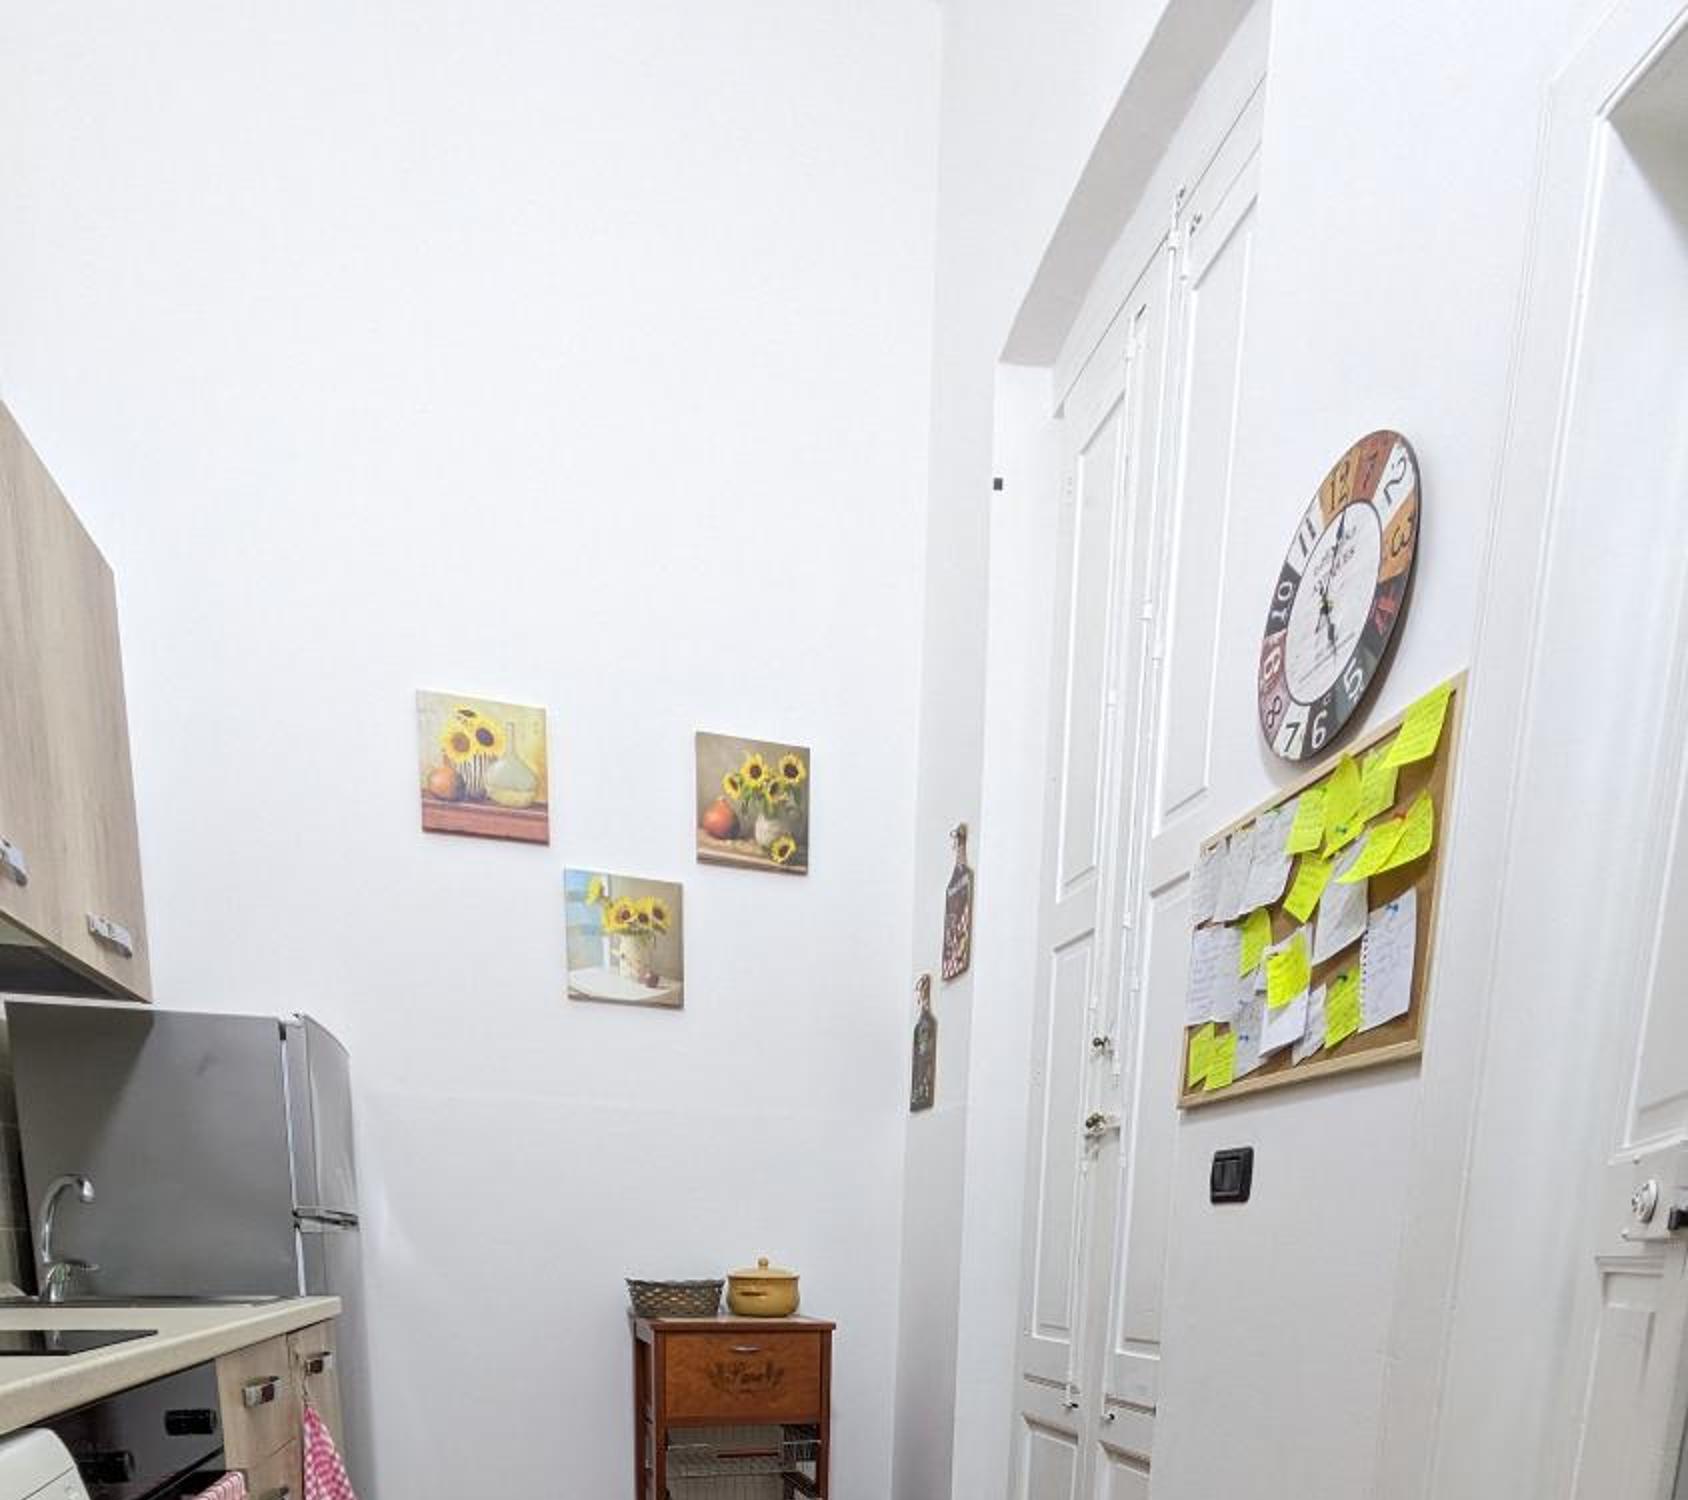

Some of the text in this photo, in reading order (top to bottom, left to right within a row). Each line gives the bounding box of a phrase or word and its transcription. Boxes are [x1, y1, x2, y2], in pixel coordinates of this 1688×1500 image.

[1383, 456, 1406, 506] 2
[1299, 517, 1316, 557] 11
[1391, 511, 1414, 557] 3
[1271, 581, 1292, 625] 10
[1343, 657, 1363, 697] 5
[1266, 695, 1283, 729] 8
[1311, 709, 1328, 750] 6
[1285, 721, 1300, 753] 7
